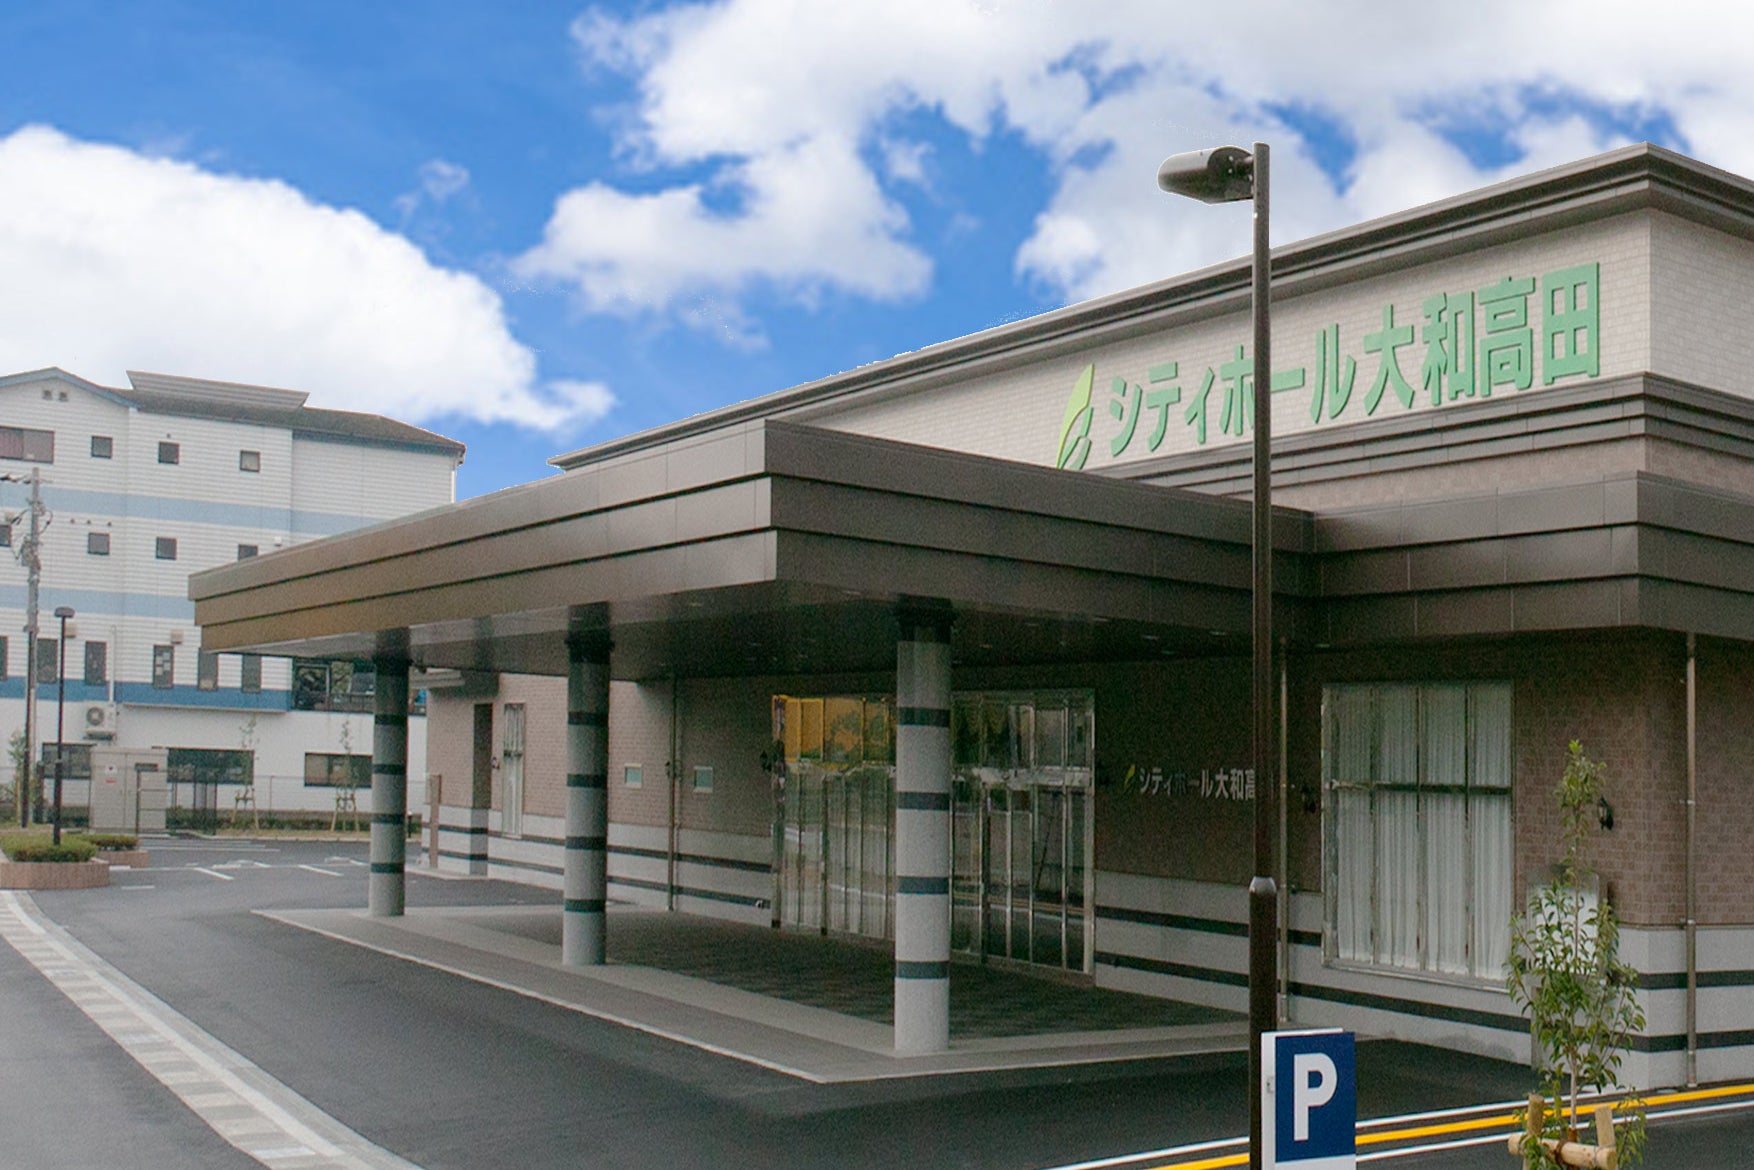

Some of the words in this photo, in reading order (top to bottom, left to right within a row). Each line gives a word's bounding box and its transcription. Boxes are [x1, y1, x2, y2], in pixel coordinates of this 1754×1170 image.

[1108, 261, 1600, 457] シティホール大和高田
[1139, 767, 1273, 801] シティホール大和高
[1293, 1052, 1338, 1142] P
